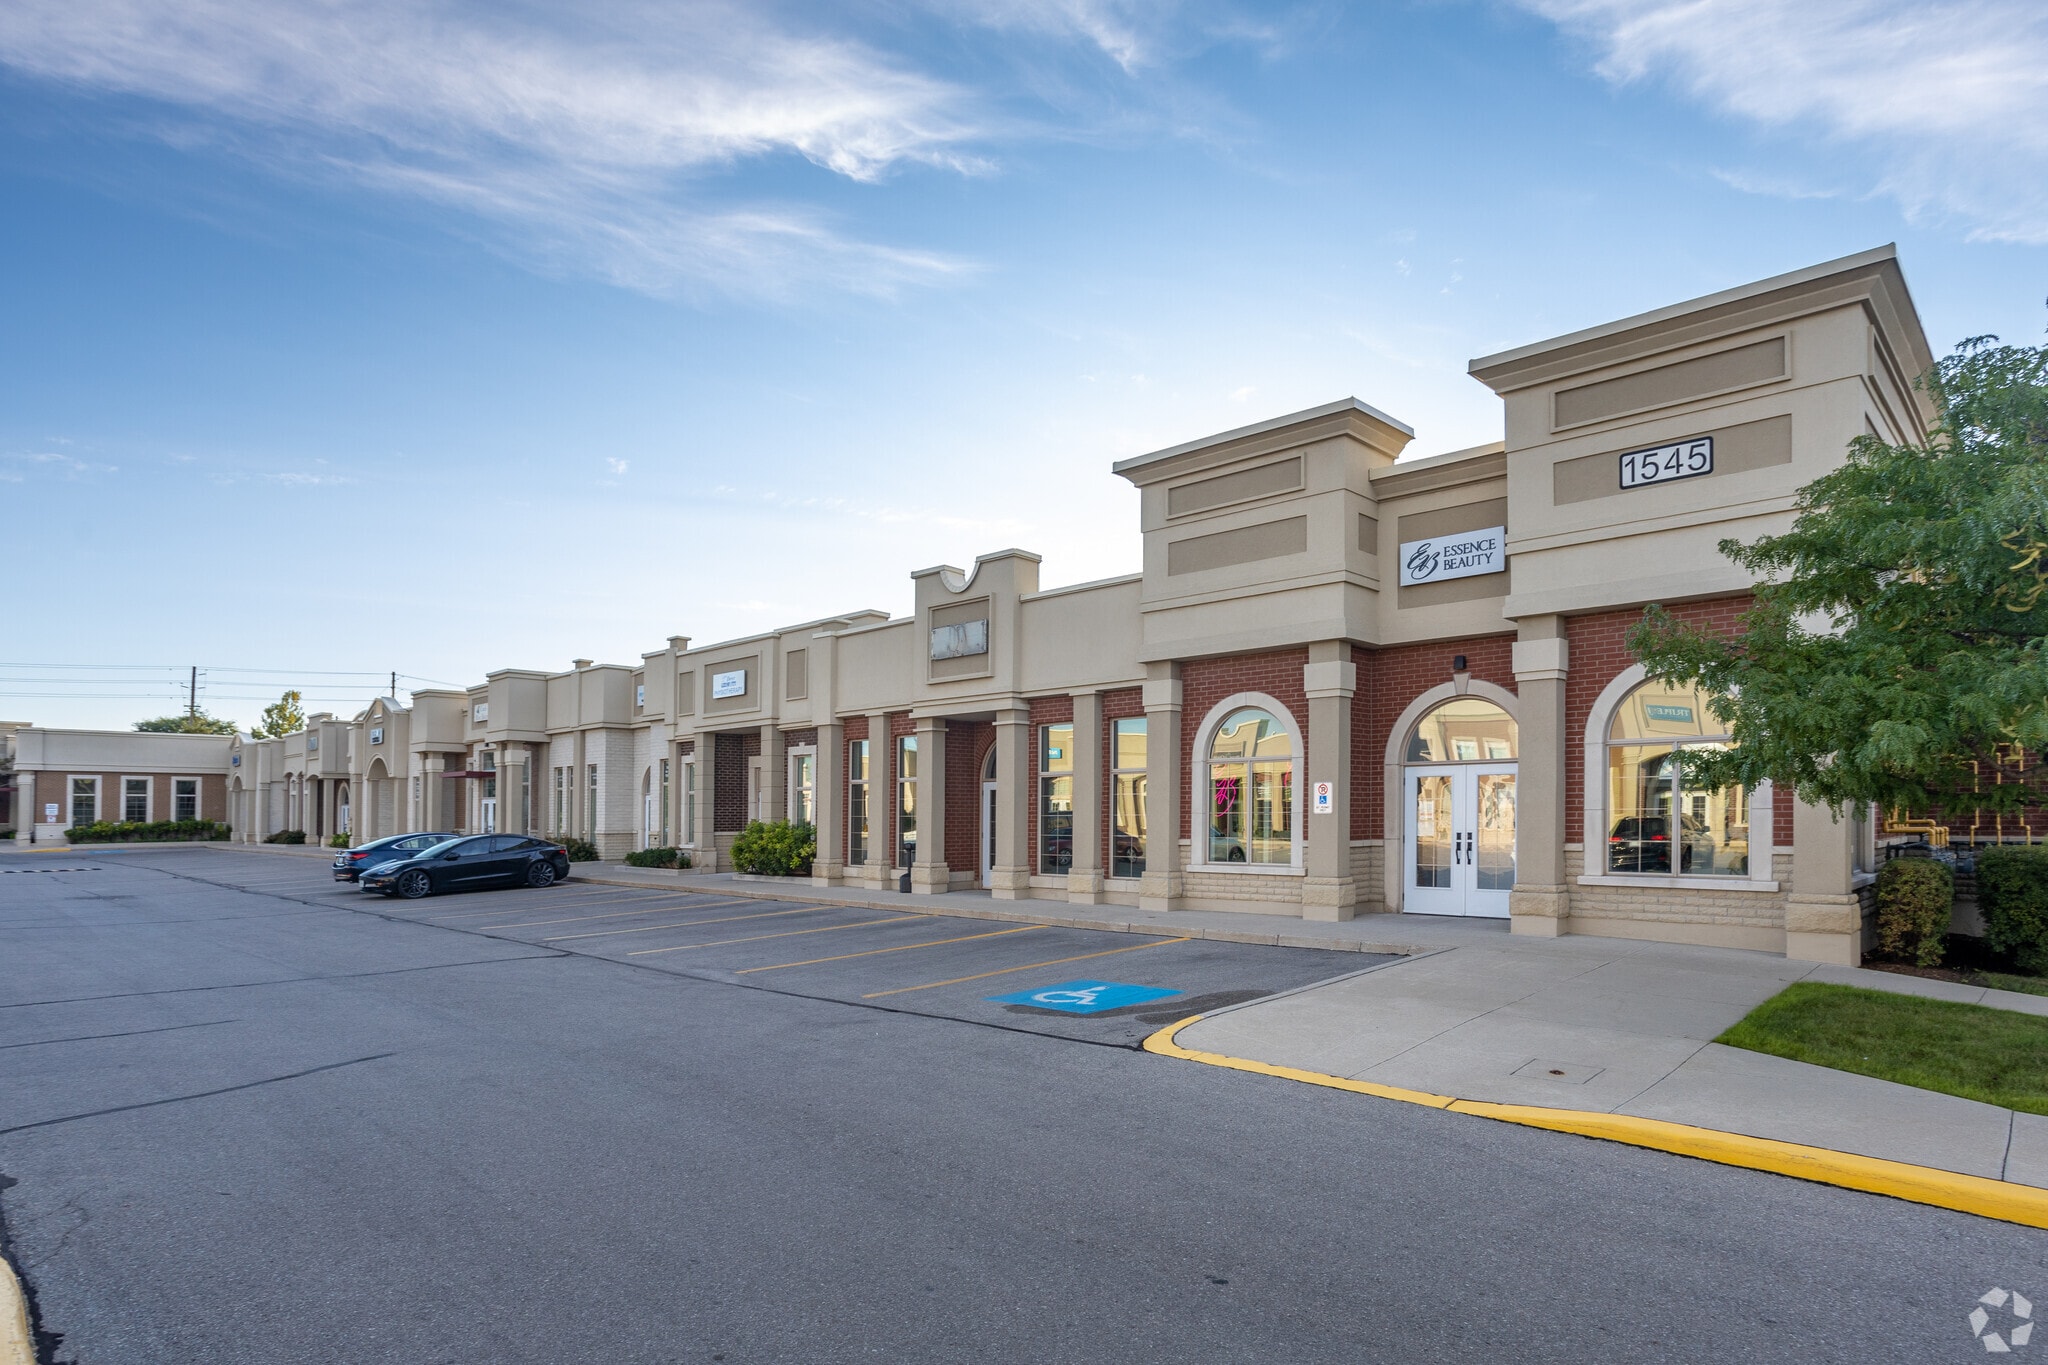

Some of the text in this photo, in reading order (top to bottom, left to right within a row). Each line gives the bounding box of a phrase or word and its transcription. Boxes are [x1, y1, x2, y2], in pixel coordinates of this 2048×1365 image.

[1624, 443, 1707, 483] 1545
[1443, 538, 1497, 558] ESSENCE
[1443, 552, 1494, 571] BEAUTY
